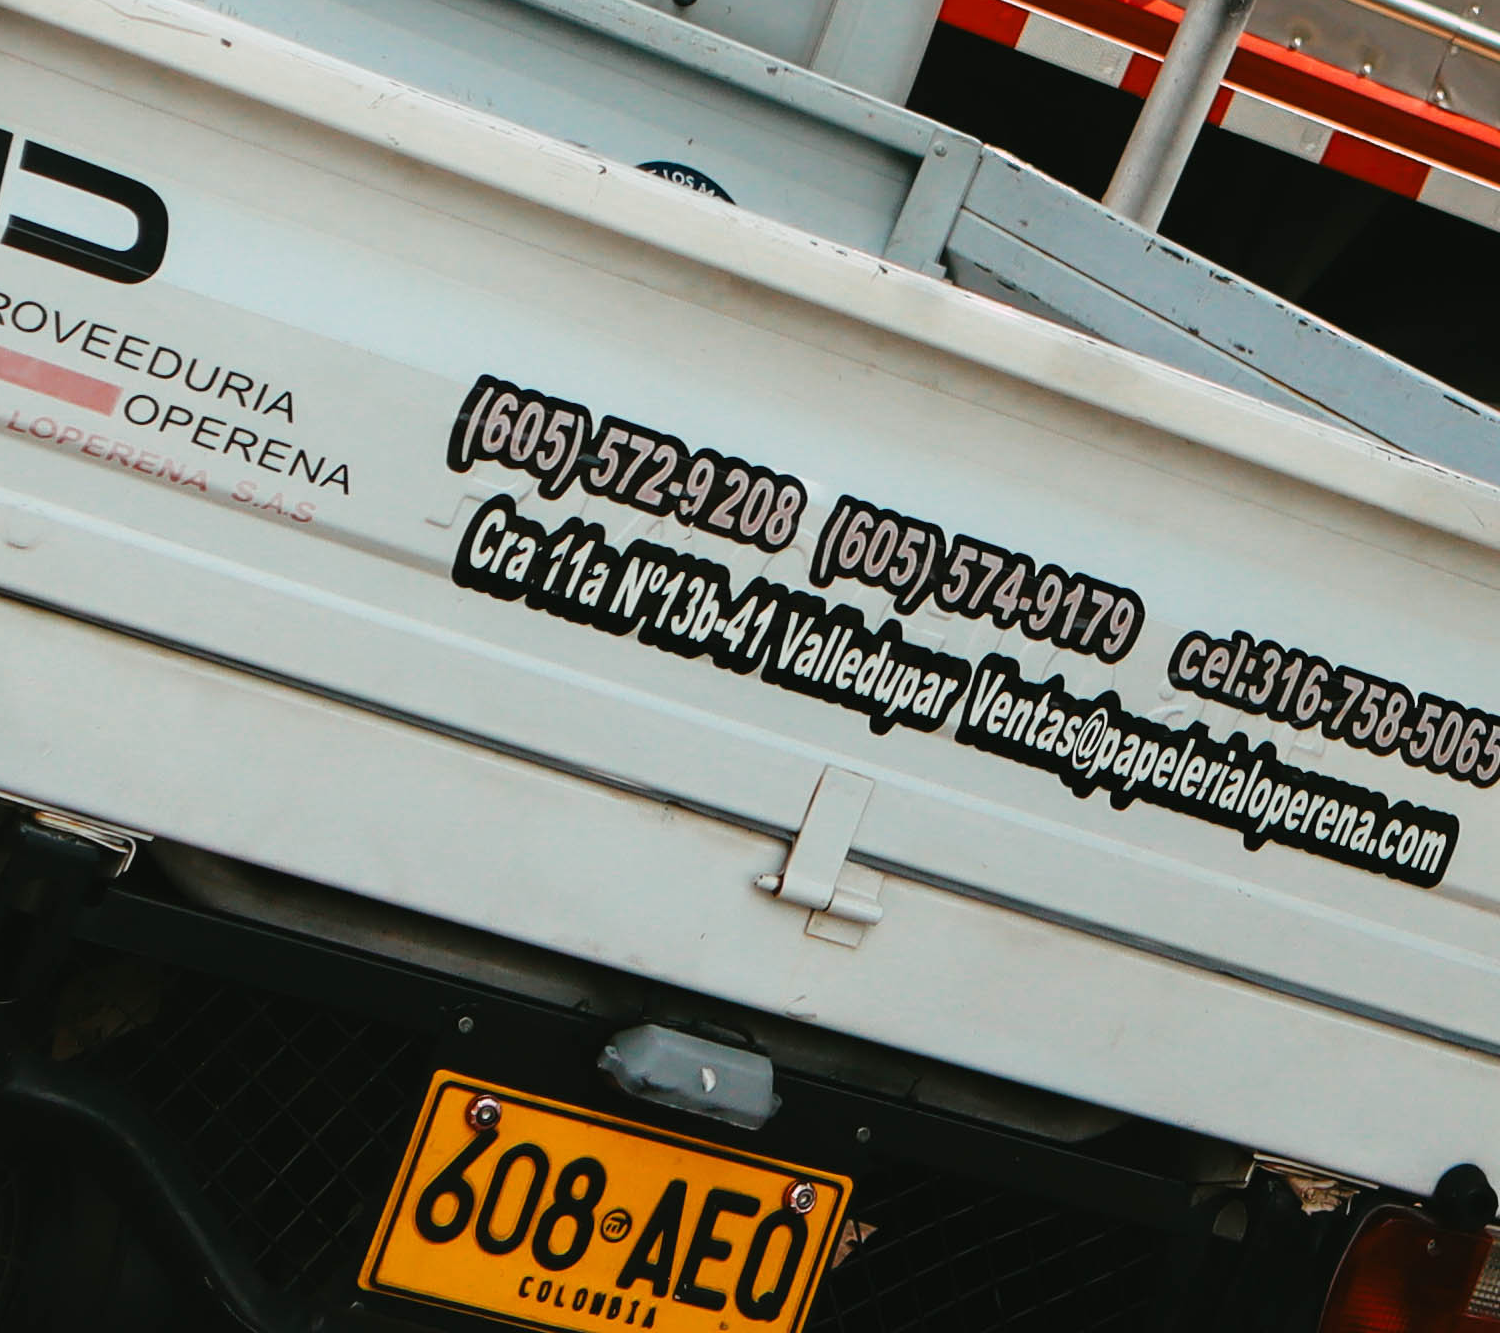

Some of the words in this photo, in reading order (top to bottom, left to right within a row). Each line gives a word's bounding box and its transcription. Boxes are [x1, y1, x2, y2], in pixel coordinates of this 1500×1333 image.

[7, 410, 208, 492] LOPERENA
[122, 392, 352, 496] OPERENA
[460, 385, 585, 495] (605)
[818, 505, 935, 605] (605)
[943, 545, 1135, 659] 574-9179
[469, 508, 529, 583] Cra
[777, 612, 959, 725] Valledupar
[967, 669, 1447, 876] Ventas@papelerialoperena.com
[414, 1130, 607, 1271] 608
[518, 1275, 657, 1329] COLOMBIA
